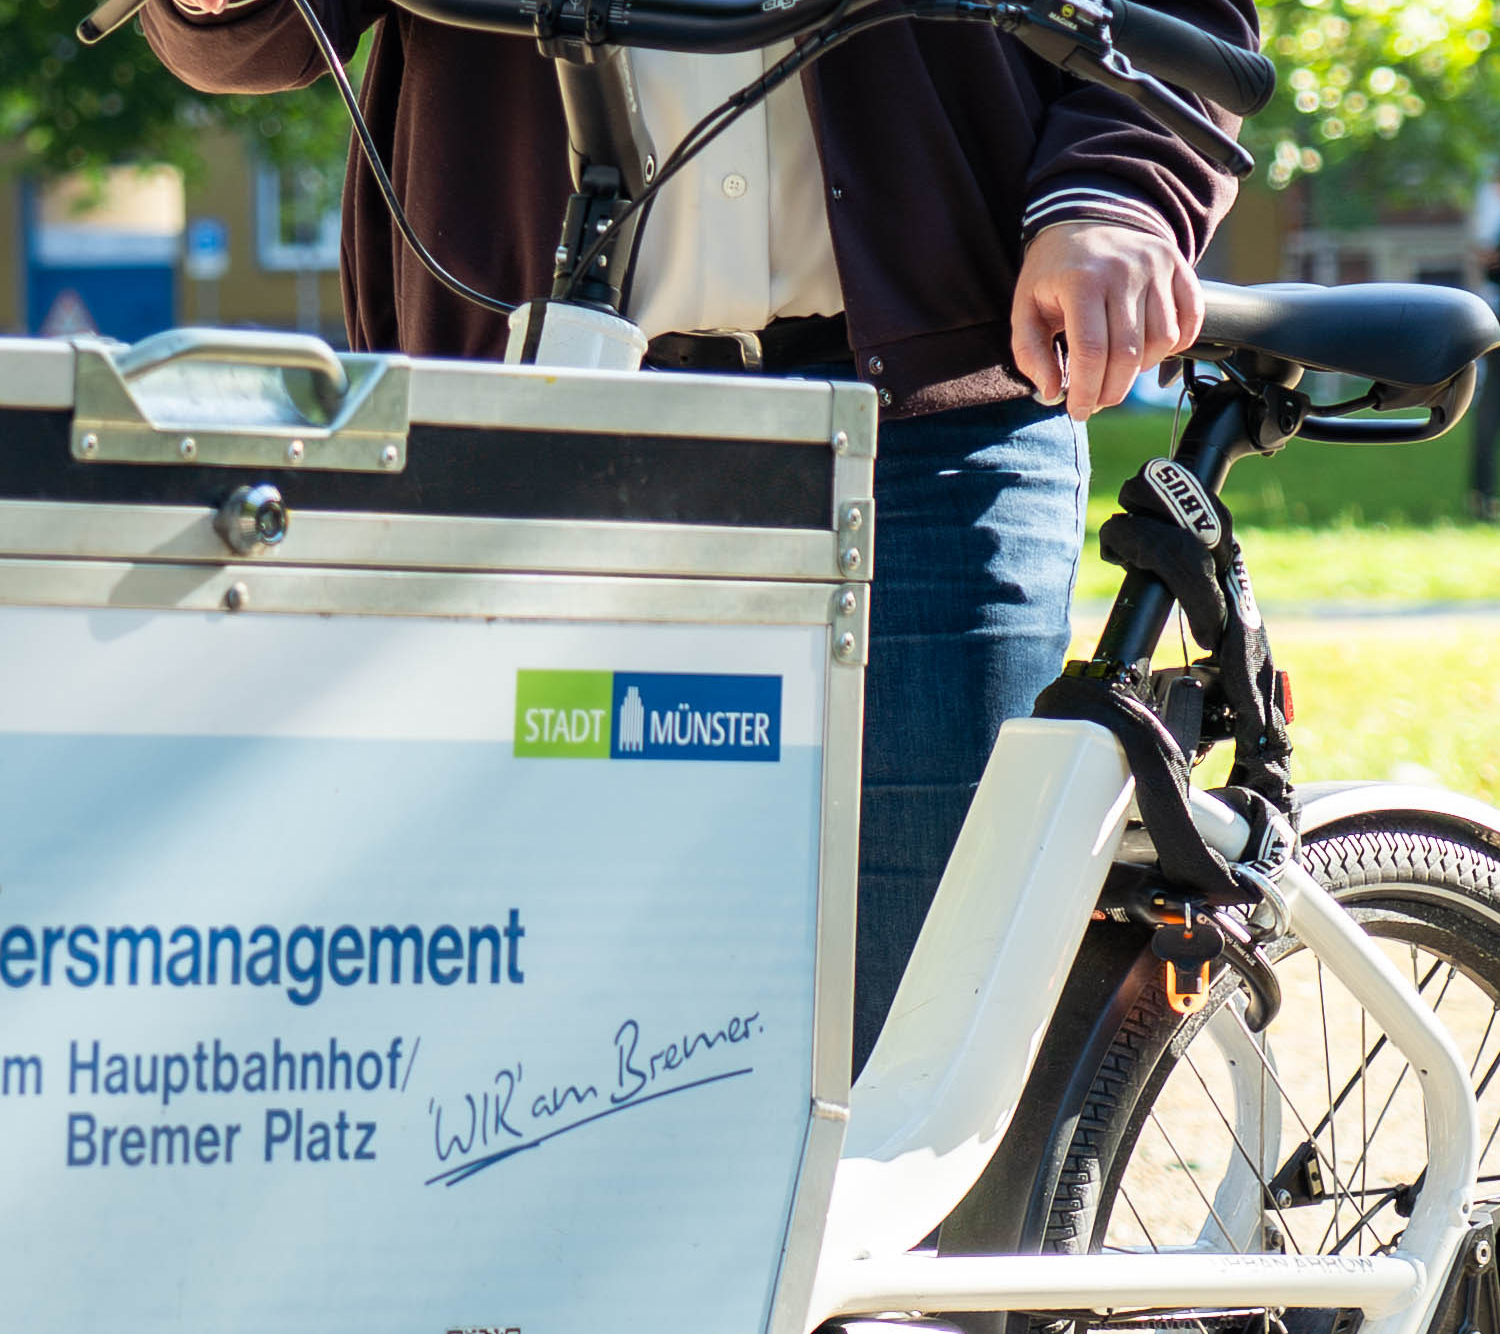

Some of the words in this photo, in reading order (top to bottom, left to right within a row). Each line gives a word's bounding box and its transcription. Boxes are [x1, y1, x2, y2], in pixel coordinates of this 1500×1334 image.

[1156, 465, 1216, 533] ABUS
[524, 707, 606, 744] STADT
[650, 702, 770, 747] MÜNSTER
[1250, 835, 1288, 877] ABU
[67, 1035, 421, 1105] Hauptbahnhof/
[531, 1084, 598, 1118] am
[66, 1110, 242, 1168] Bremer
[263, 1108, 378, 1163] Platz
